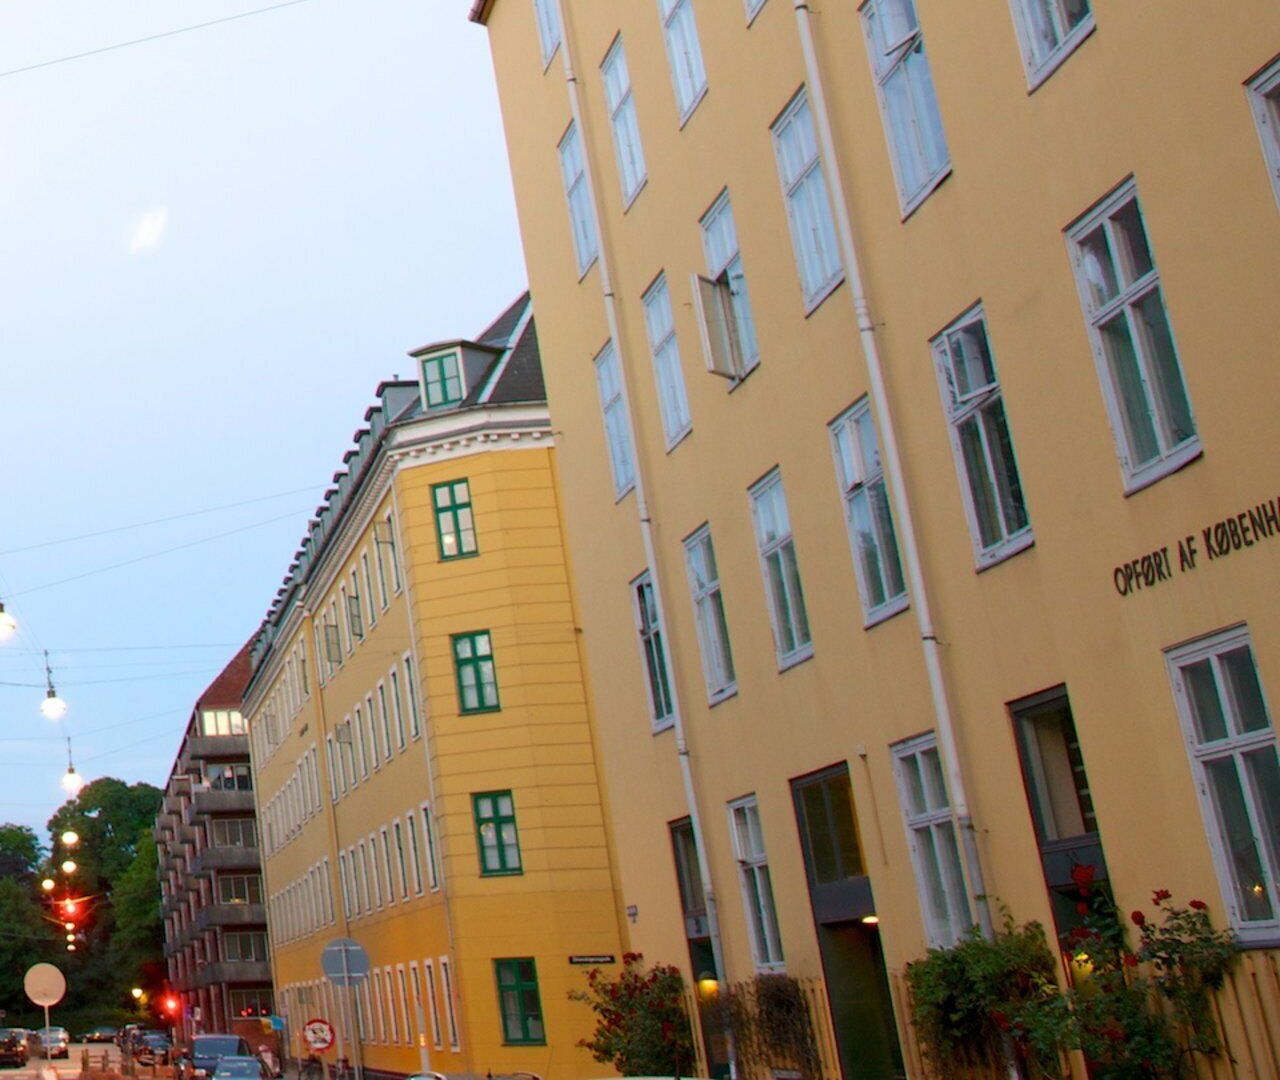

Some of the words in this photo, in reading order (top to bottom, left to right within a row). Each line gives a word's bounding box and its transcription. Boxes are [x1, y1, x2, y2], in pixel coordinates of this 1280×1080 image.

[1113, 546, 1172, 597] OPFØRT
[1177, 535, 1198, 572] AF
[1202, 496, 1280, 560] KØBENH
